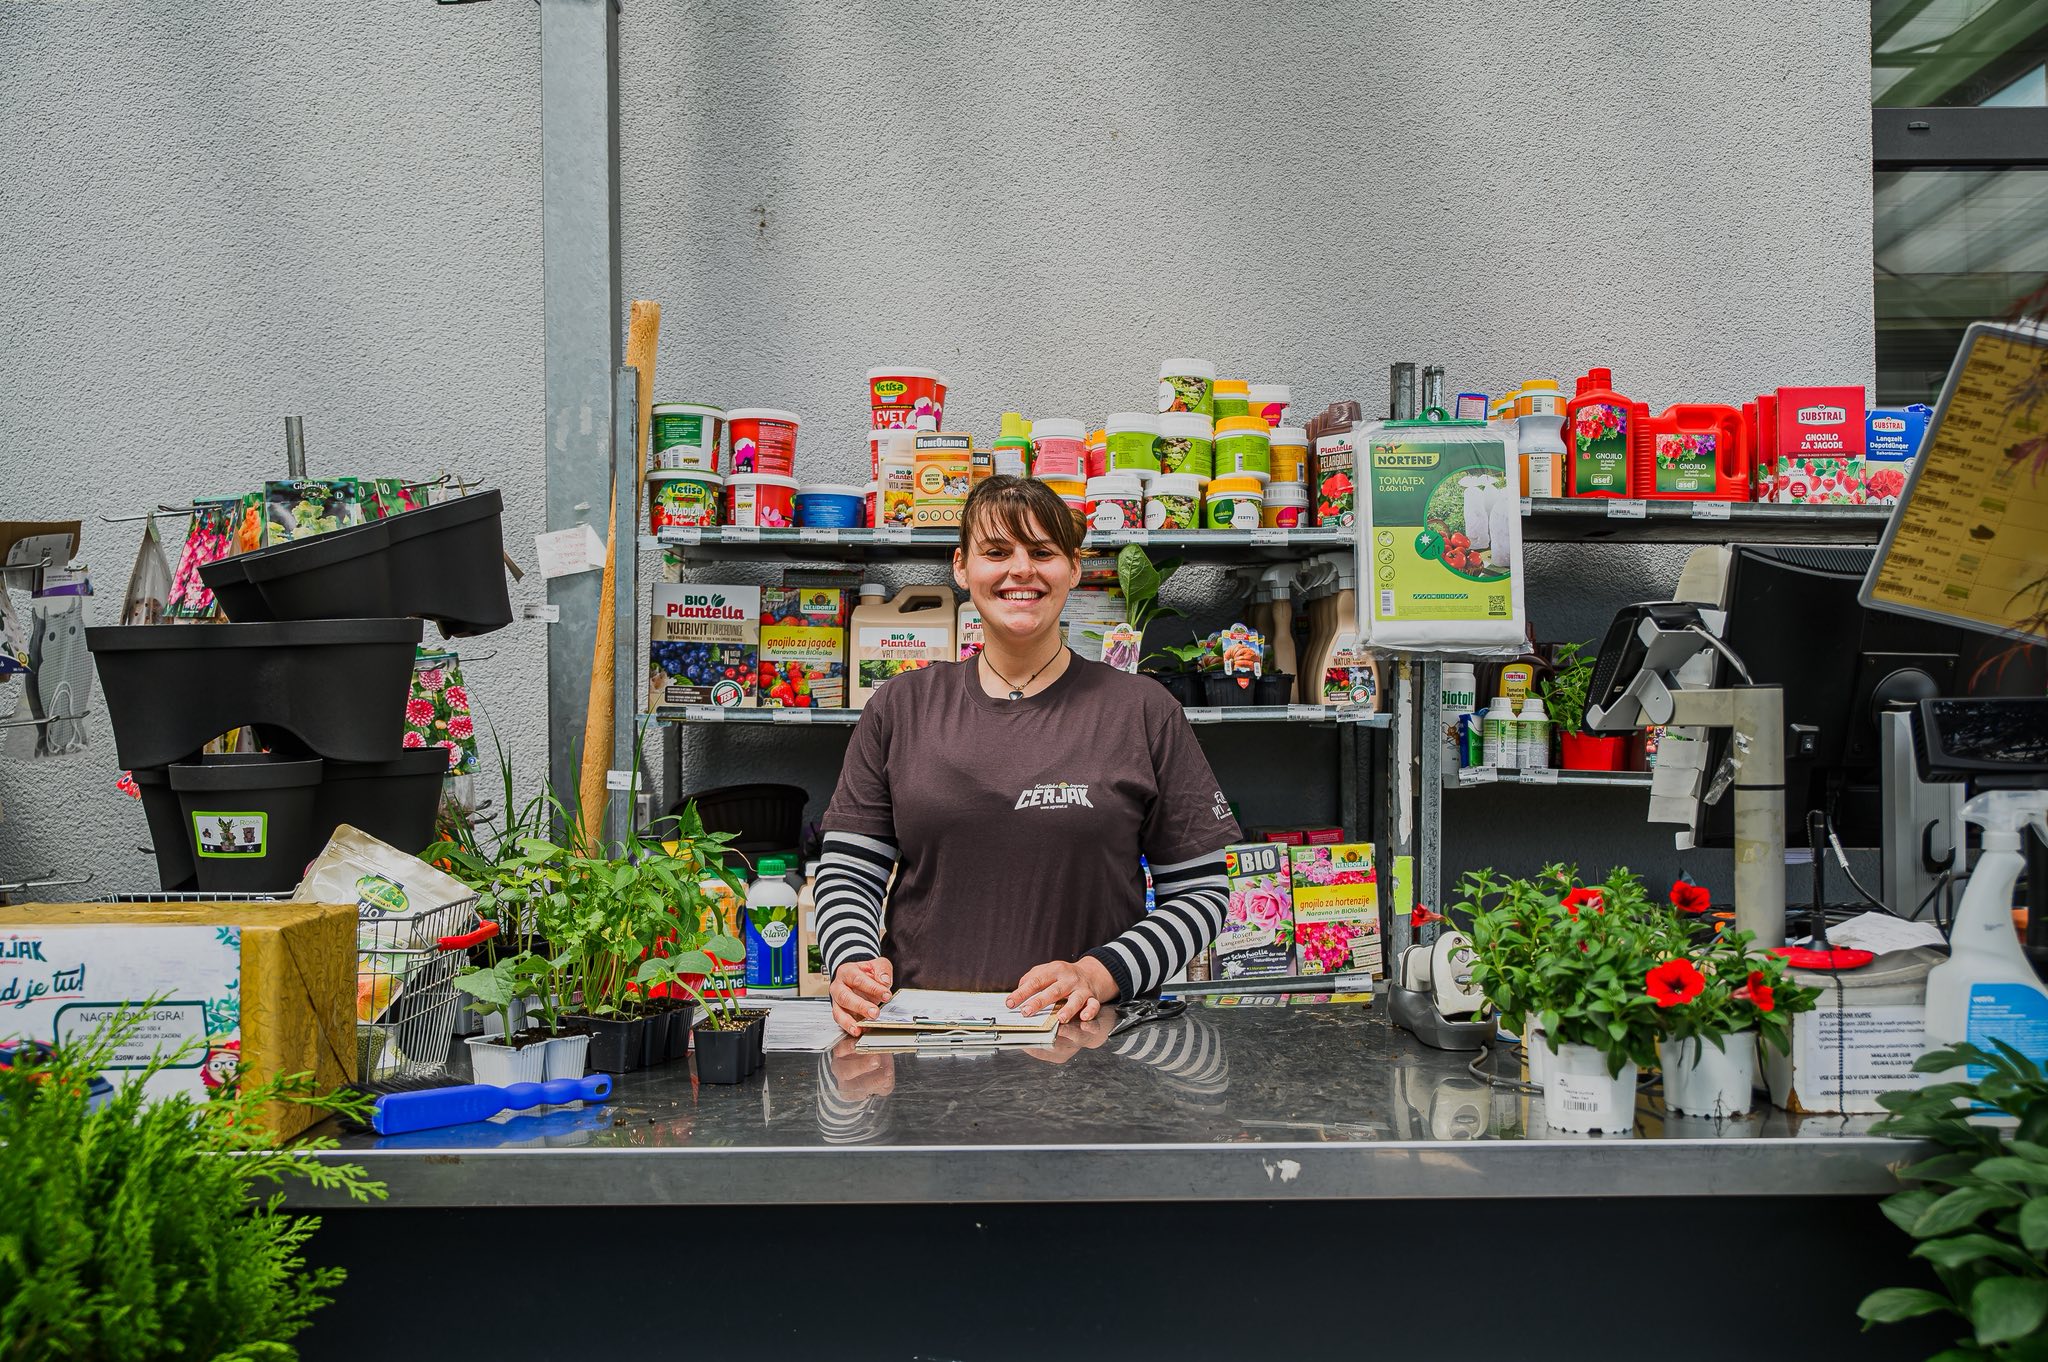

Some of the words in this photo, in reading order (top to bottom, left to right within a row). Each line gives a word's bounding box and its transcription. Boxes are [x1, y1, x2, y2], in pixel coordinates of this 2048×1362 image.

[875, 381, 904, 392] Vetisa
[876, 410, 906, 422] CVET
[1800, 411, 1843, 421] SUBSTRAL
[1874, 422, 1904, 430] SUBSTRAL
[1805, 433, 1839, 441] GNOJILO
[1320, 443, 1353, 455] Plantella
[1800, 441, 1811, 449] ZA
[1813, 441, 1843, 449] JAGODE
[1869, 442, 1909, 450] Depotdünger
[1377, 455, 1433, 465] NORTENE
[1595, 452, 1623, 460] GNOJILO
[1379, 476, 1425, 485] TOMATEX
[1593, 475, 1611, 484] asef
[1678, 480, 1696, 488] asef
[379, 483, 391, 495] 10
[671, 484, 703, 495] Vetisa
[336, 491, 344, 500] D
[684, 594, 708, 606] BIO
[667, 603, 745, 620] Plantella
[666, 621, 709, 636] NUTRIVIT
[891, 633, 905, 641] BIO
[962, 632, 975, 642] VRT
[767, 637, 796, 649] gnojilo
[808, 637, 837, 651] jagode
[880, 639, 927, 648] Plantella
[882, 650, 894, 659] VRT
[720, 690, 736, 704] TEST
[1441, 691, 1474, 706] Biotoll
[1014, 788, 1094, 810] CERJAK
[1240, 849, 1276, 873] BIO
[1335, 861, 1370, 869] NEUDORFF
[358, 901, 380, 918] BIO
[1299, 900, 1324, 912] gnojilo
[1334, 896, 1370, 907] hortenzije
[1305, 909, 1333, 917] Naravno
[1334, 908, 1340, 916] in
[1341, 907, 1368, 915] BIOloško
[763, 925, 790, 939] Slavol
[1232, 931, 1253, 941] Rosen
[1231, 949, 1269, 961] Schafwolle
[0, 977, 21, 1002] d
[14, 979, 50, 1009] je
[52, 962, 86, 993] tu!
[152, 1010, 185, 1021] IGRA!
